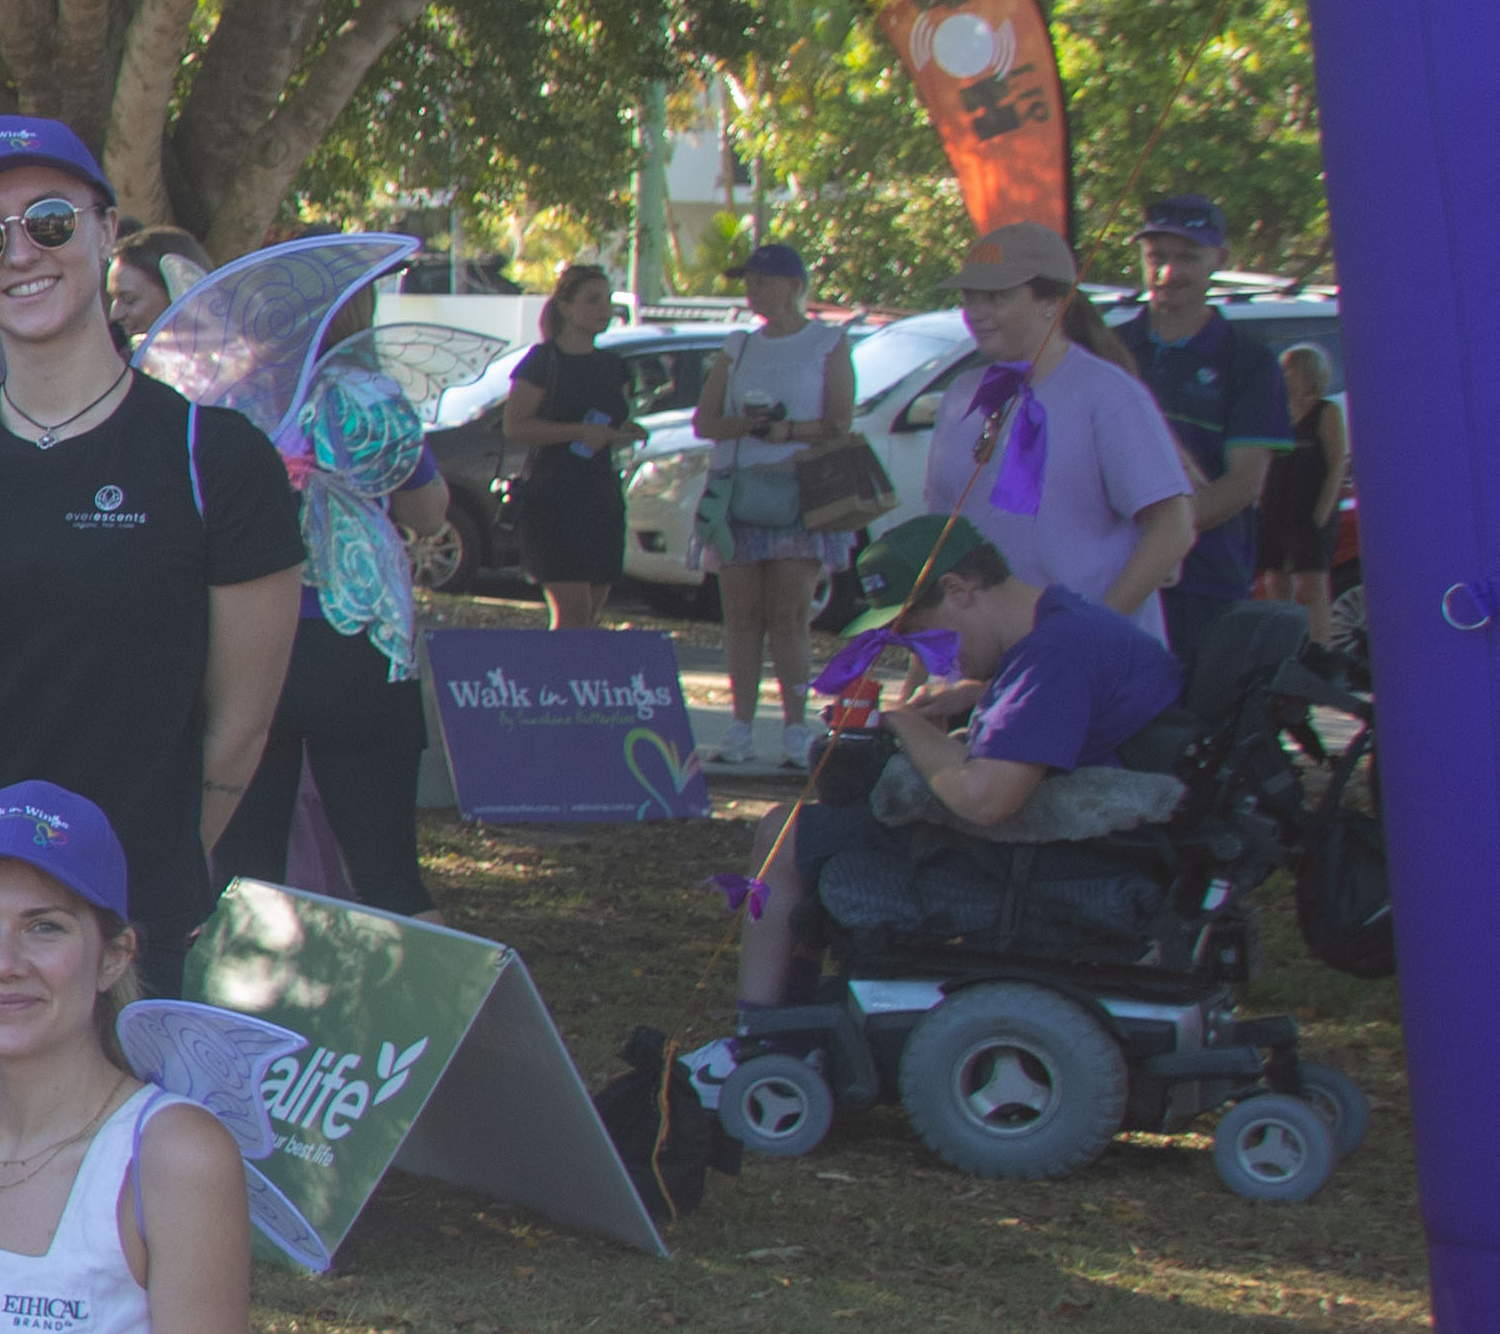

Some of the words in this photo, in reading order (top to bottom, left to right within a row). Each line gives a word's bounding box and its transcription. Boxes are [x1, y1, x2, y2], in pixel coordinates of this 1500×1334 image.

[446, 670, 532, 709] Walk
[538, 684, 569, 707] in
[568, 673, 673, 721] Wings
[260, 1046, 371, 1141] alife
[2, 1294, 89, 1320] ETHICAL
